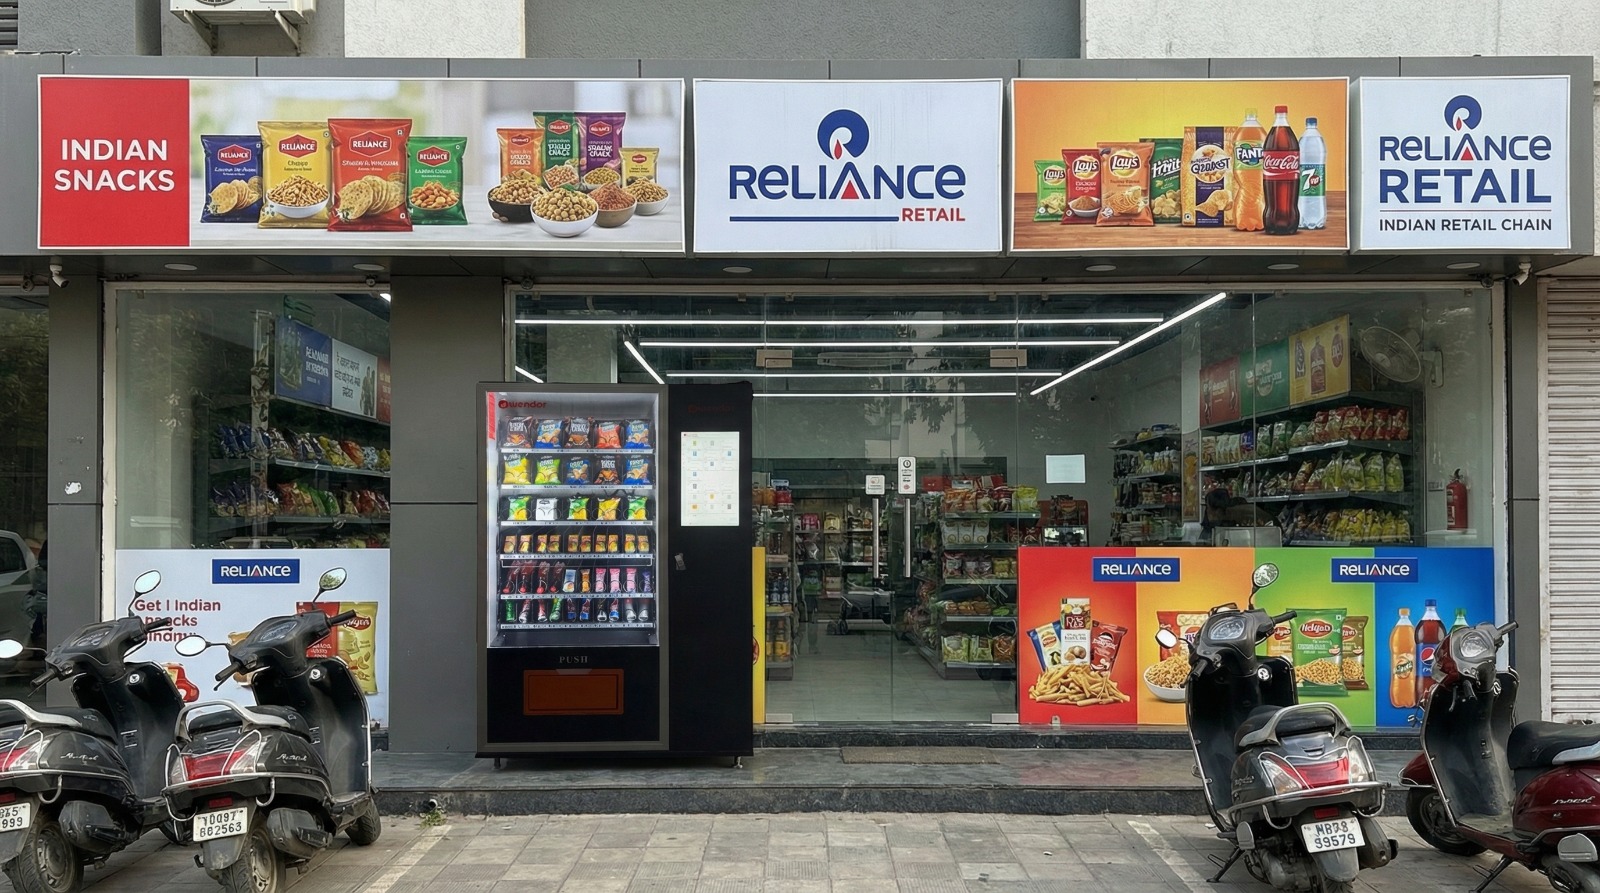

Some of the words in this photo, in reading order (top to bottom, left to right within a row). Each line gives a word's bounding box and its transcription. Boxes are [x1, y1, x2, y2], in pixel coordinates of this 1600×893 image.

[61, 139, 167, 161] INDIAN
[281, 142, 315, 151] RELIANCE
[352, 140, 388, 148] RELIANCE
[1236, 147, 1264, 160] FANT
[54, 169, 175, 192] SNACKS
[1379, 168, 1552, 204] RETAIL
[901, 207, 966, 222] RETAIL
[1379, 218, 1436, 231] INDIAN
[1441, 218, 1497, 231] RETAIL
[1501, 218, 1552, 231] CHAIN
[134, 599, 162, 611] Get
[175, 599, 221, 611] Indian
[559, 655, 588, 663] PUSH
